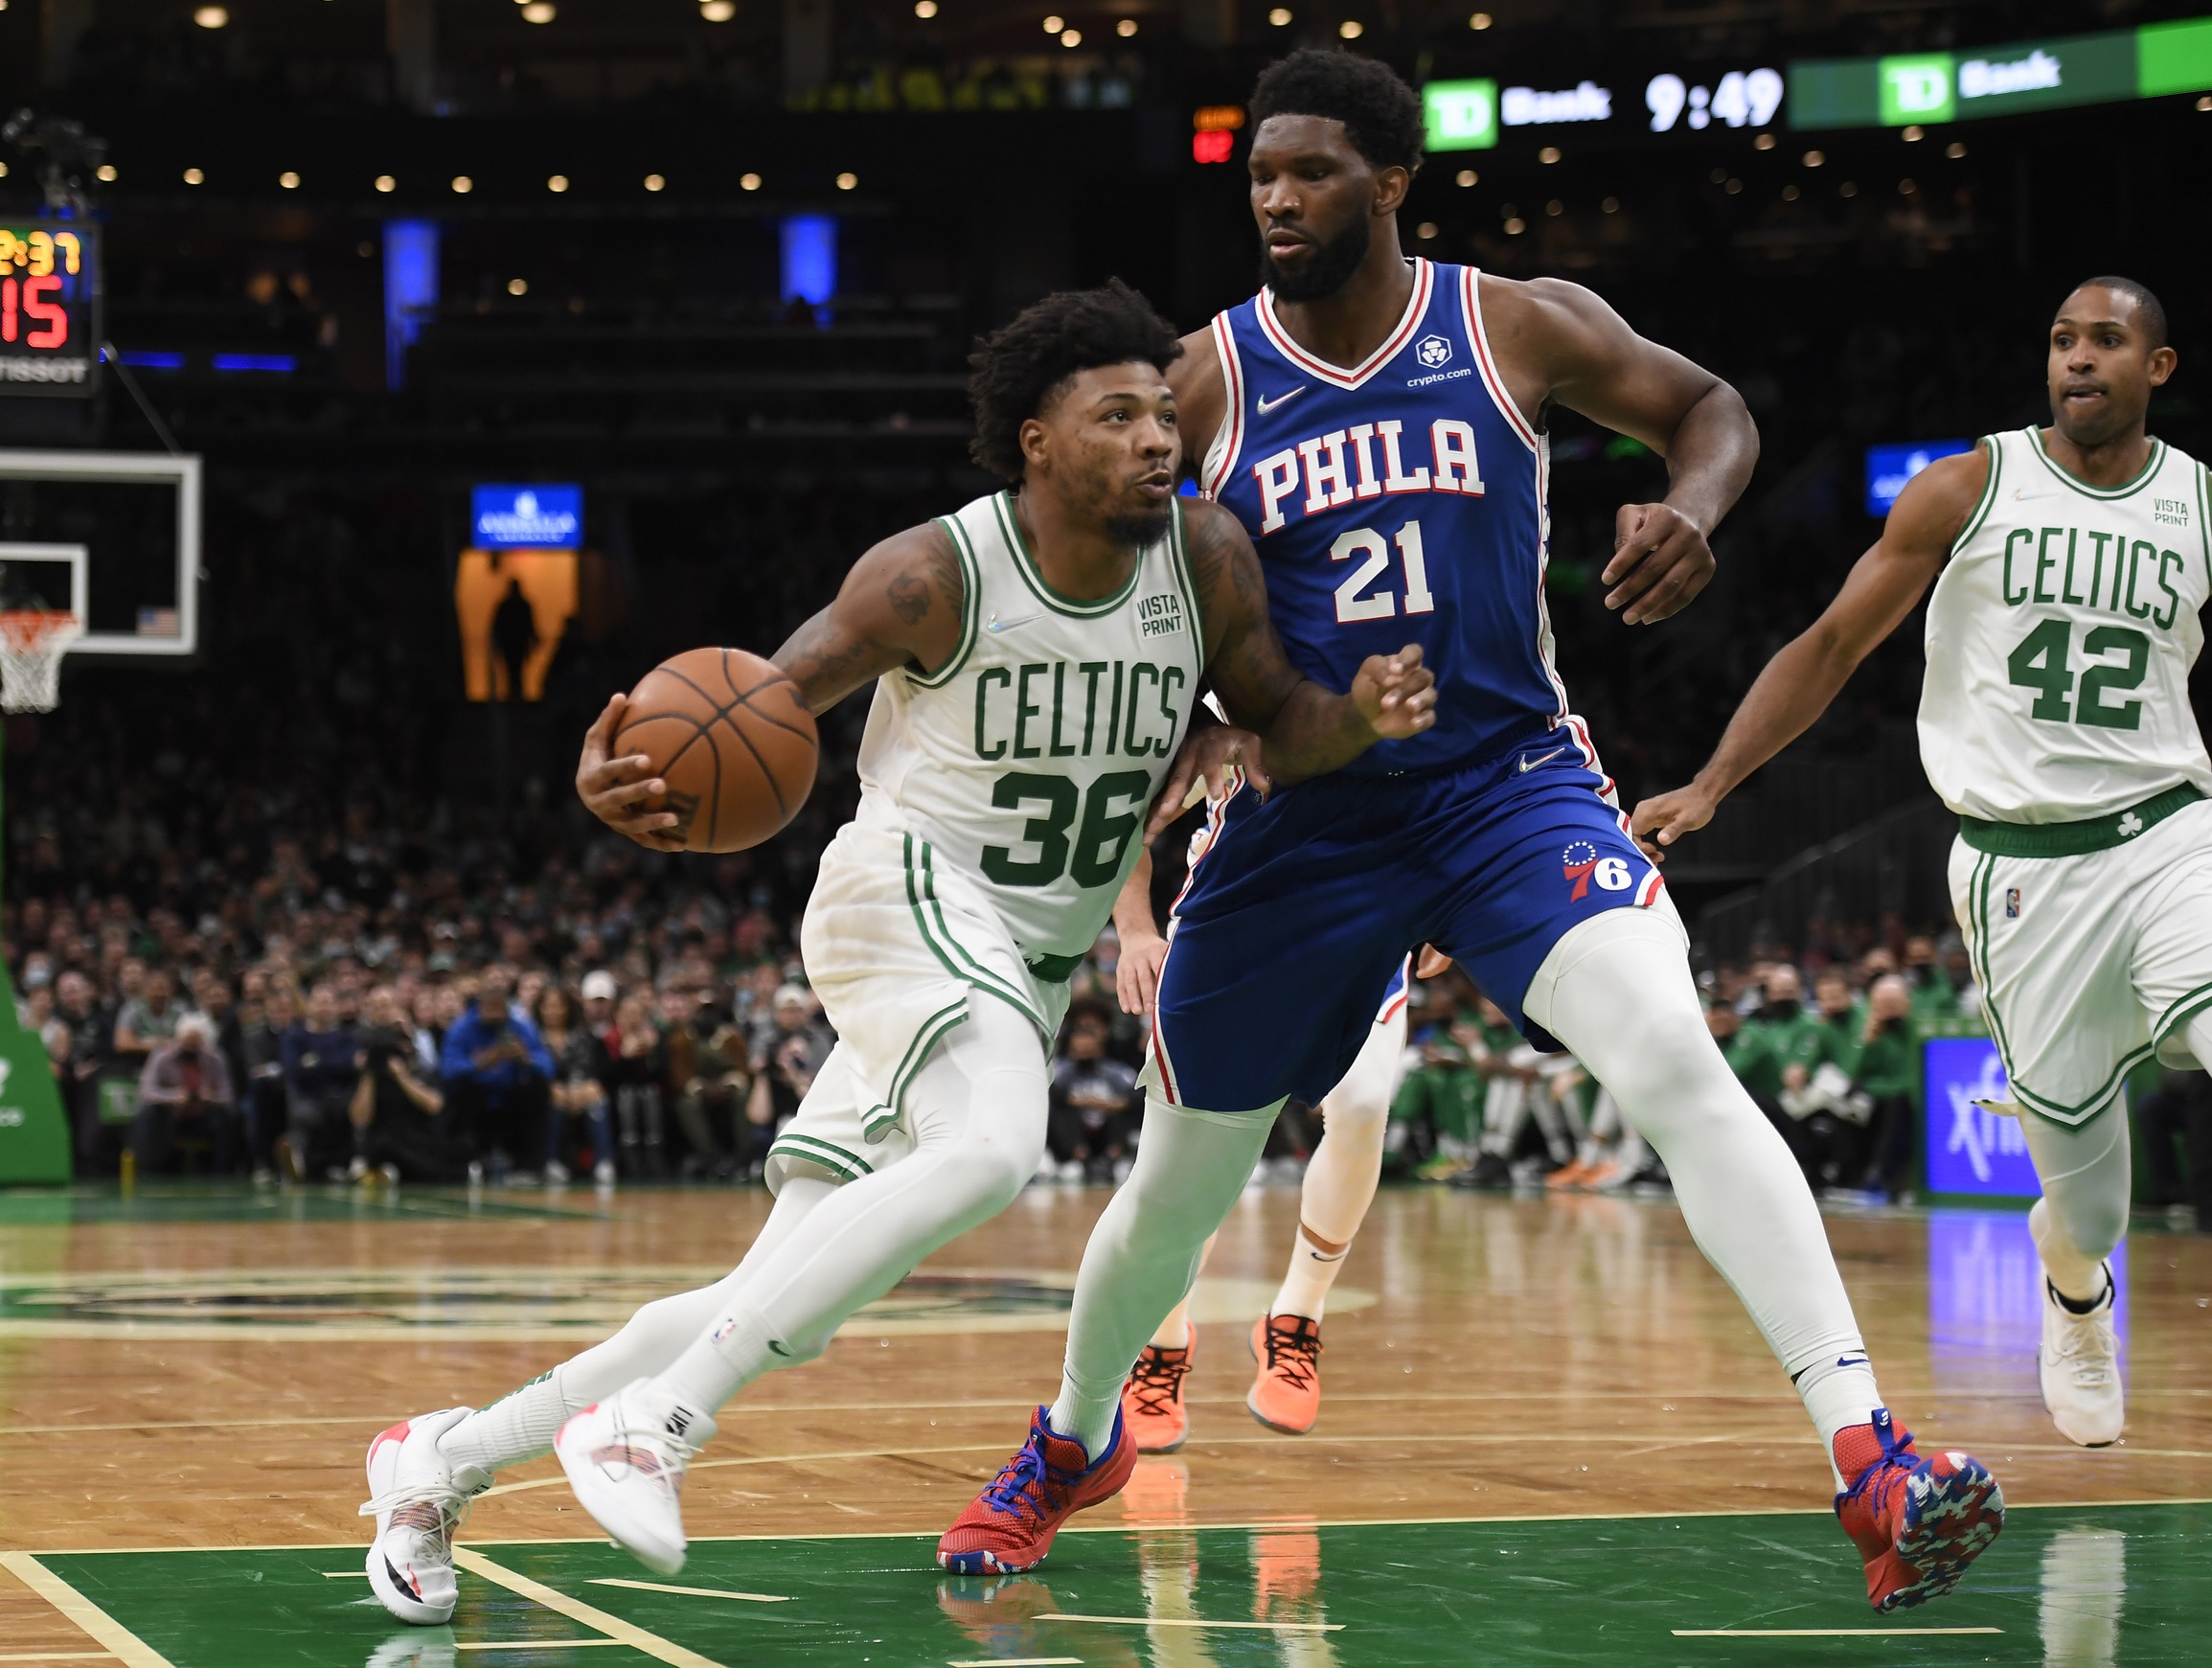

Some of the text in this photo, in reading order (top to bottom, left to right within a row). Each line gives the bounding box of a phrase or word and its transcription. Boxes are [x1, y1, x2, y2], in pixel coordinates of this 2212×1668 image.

[1428, 80, 1612, 137] TD Bank
[1645, 67, 1784, 132] 9:49
[1884, 49, 2062, 112] TD Bank
[2, 274, 68, 349] 15
[1407, 368, 1471, 387] crypto.com
[1252, 419, 1485, 537] PHILA
[2155, 498, 2188, 515] VISTA
[2155, 513, 2188, 527] PRINT
[1330, 520, 1434, 625] 21
[2003, 527, 2184, 630] CELTICS
[1137, 595, 1180, 620] VISTA
[1142, 615, 1181, 637] PRINT
[2007, 618, 2151, 731] 42
[975, 661, 1185, 761] CELTICS
[979, 769, 1152, 889] 36
[1562, 857, 1632, 903] 76
